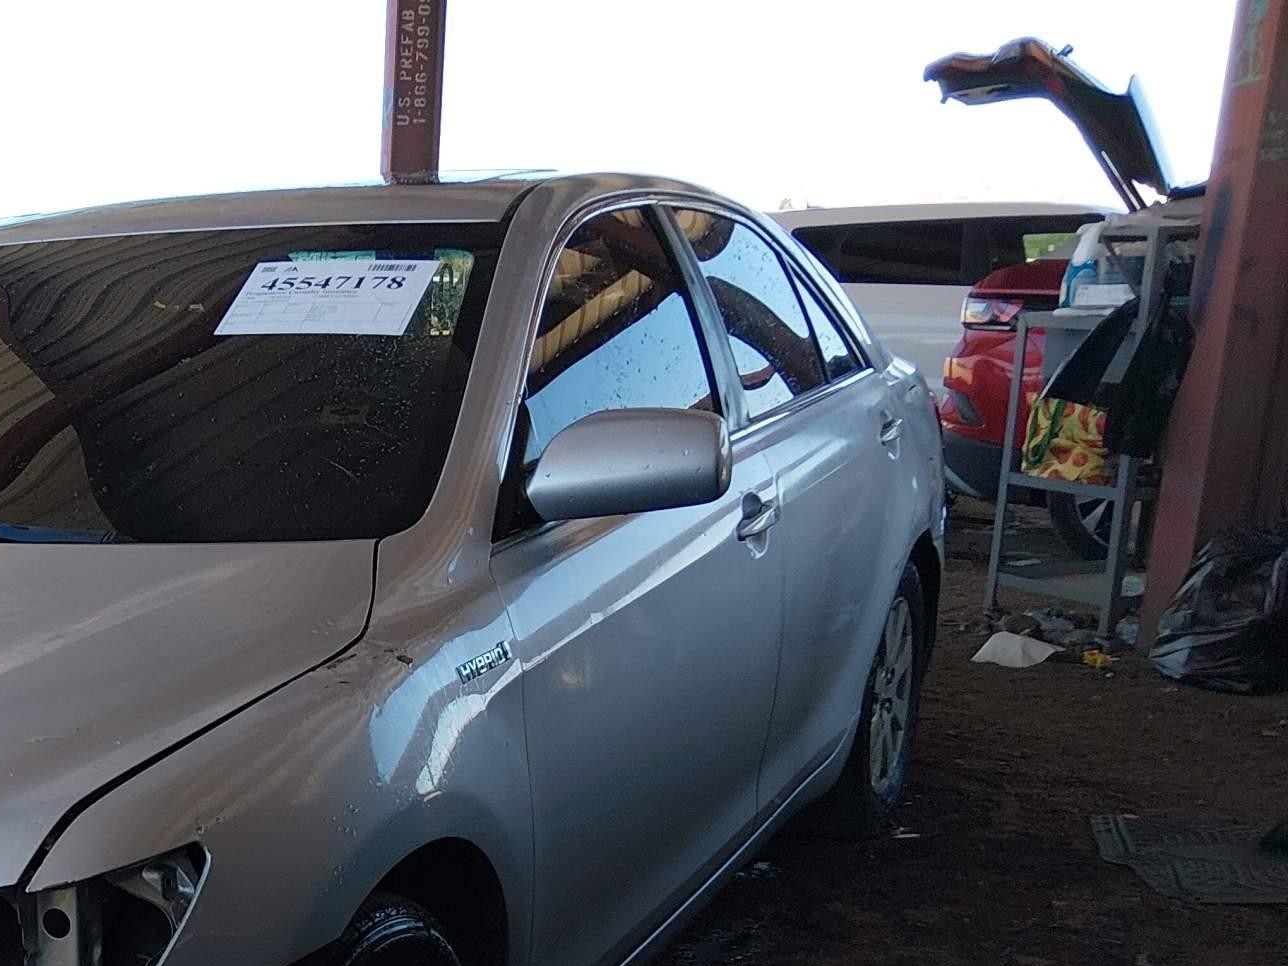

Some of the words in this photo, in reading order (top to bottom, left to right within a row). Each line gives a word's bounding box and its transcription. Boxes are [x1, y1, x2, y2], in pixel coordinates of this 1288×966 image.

[400, 9, 415, 81] PREFAB
[413, 0, 431, 124] 1-866-799-0
[397, 91, 412, 126] U.S.
[261, 275, 407, 291] 45547178
[459, 645, 507, 681] HYBRID
